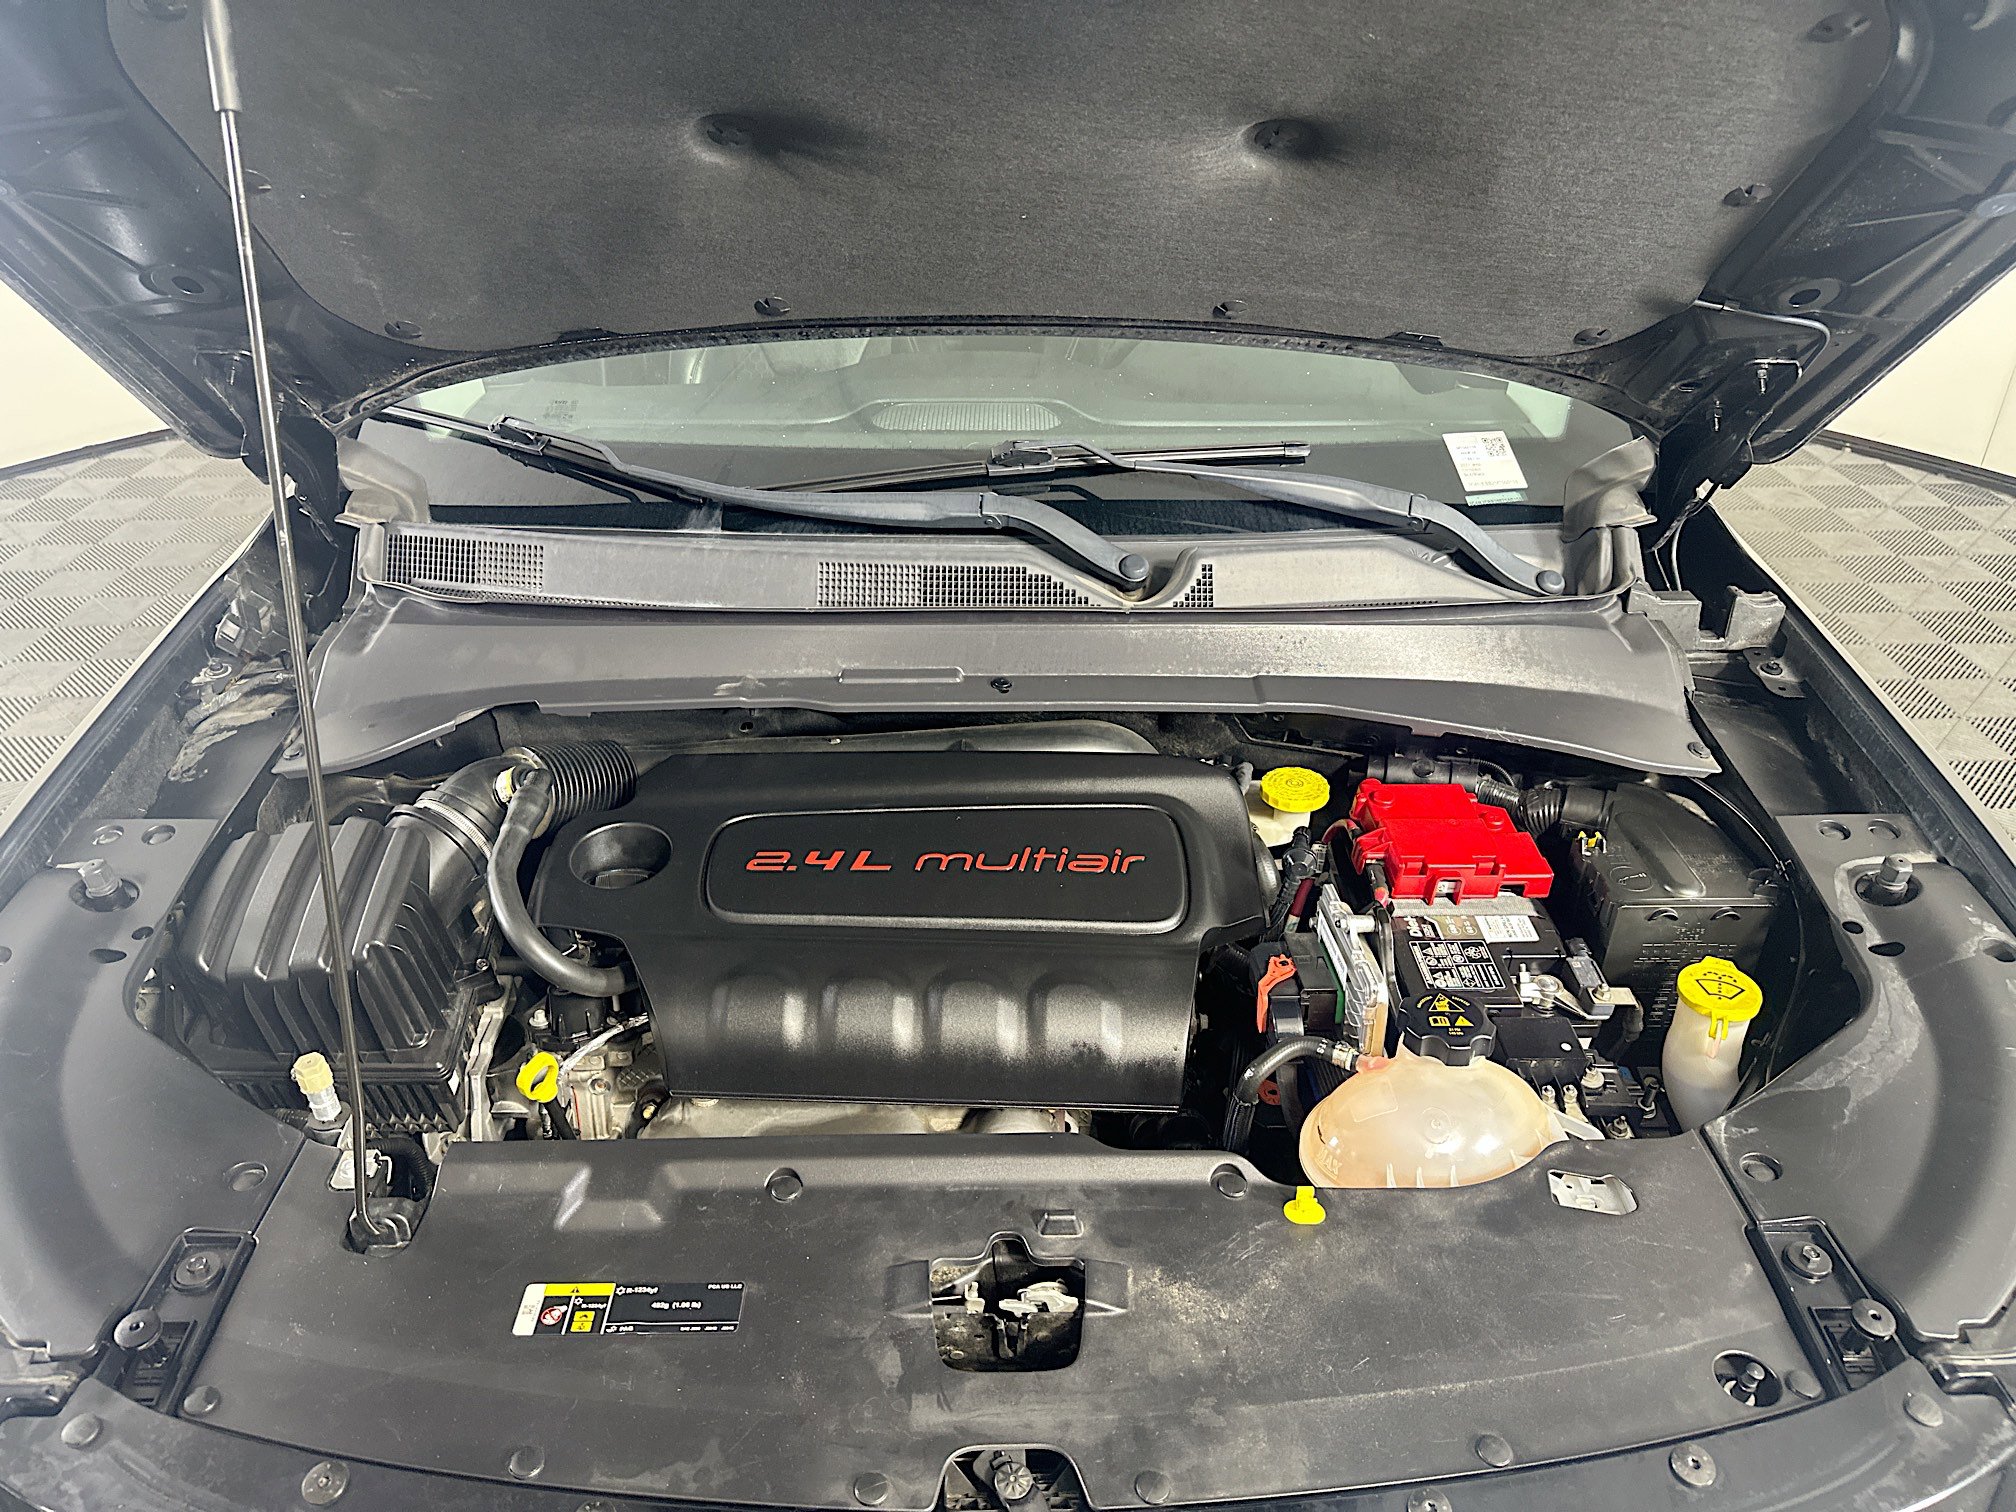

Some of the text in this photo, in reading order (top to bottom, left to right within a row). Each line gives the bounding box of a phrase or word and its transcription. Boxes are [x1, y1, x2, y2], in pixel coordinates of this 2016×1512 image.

[745, 845, 1147, 874] 2.4L multiair
[1317, 1146, 1343, 1175] MAX
[626, 1286, 659, 1295] R-1234yf
